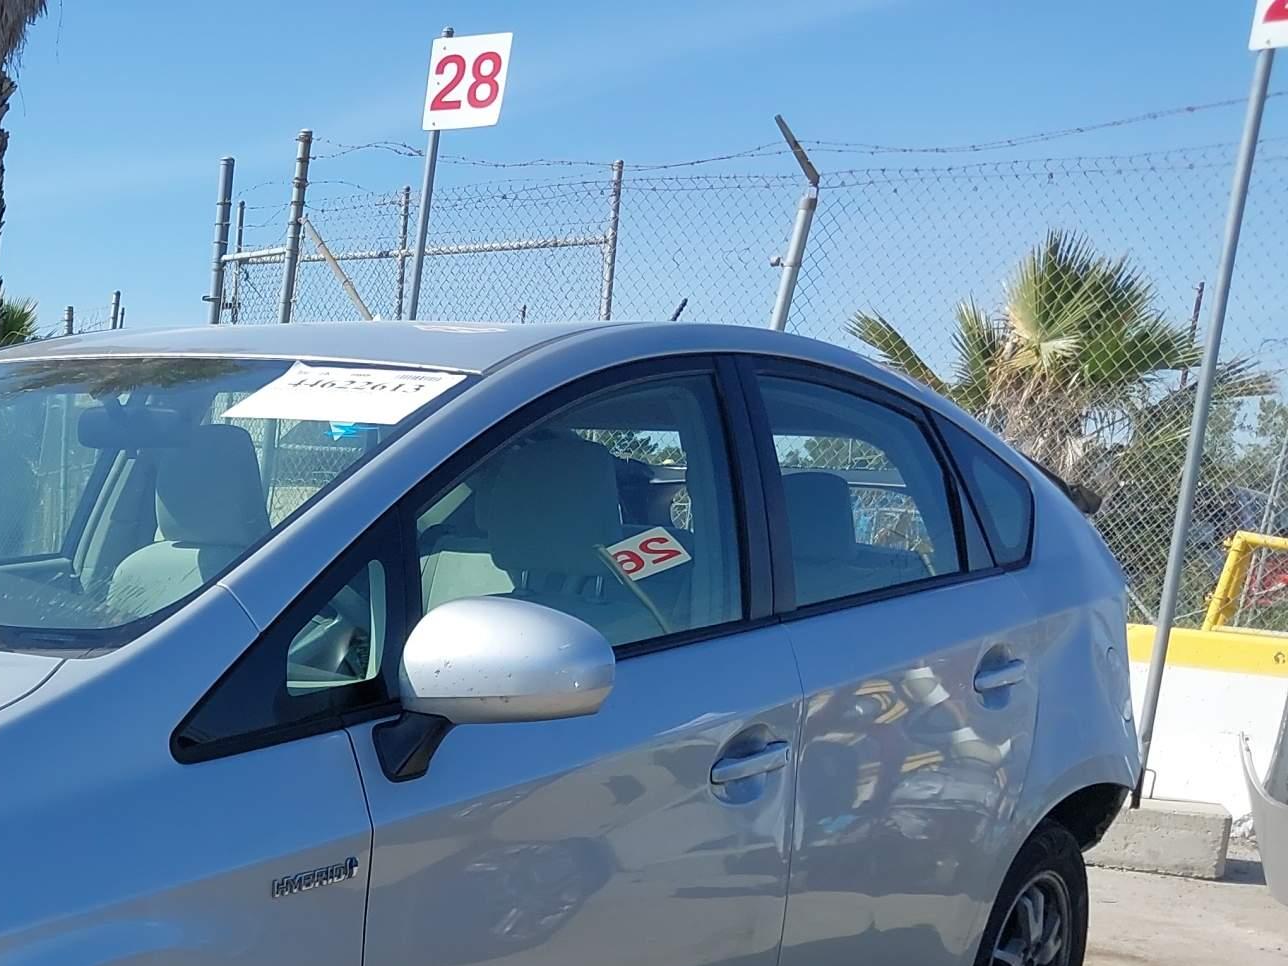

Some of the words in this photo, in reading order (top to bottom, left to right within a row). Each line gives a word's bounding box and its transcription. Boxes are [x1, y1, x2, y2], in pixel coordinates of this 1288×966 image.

[430, 51, 502, 111] 28
[288, 378, 425, 394] 44622613
[272, 863, 347, 898] HYBRID
